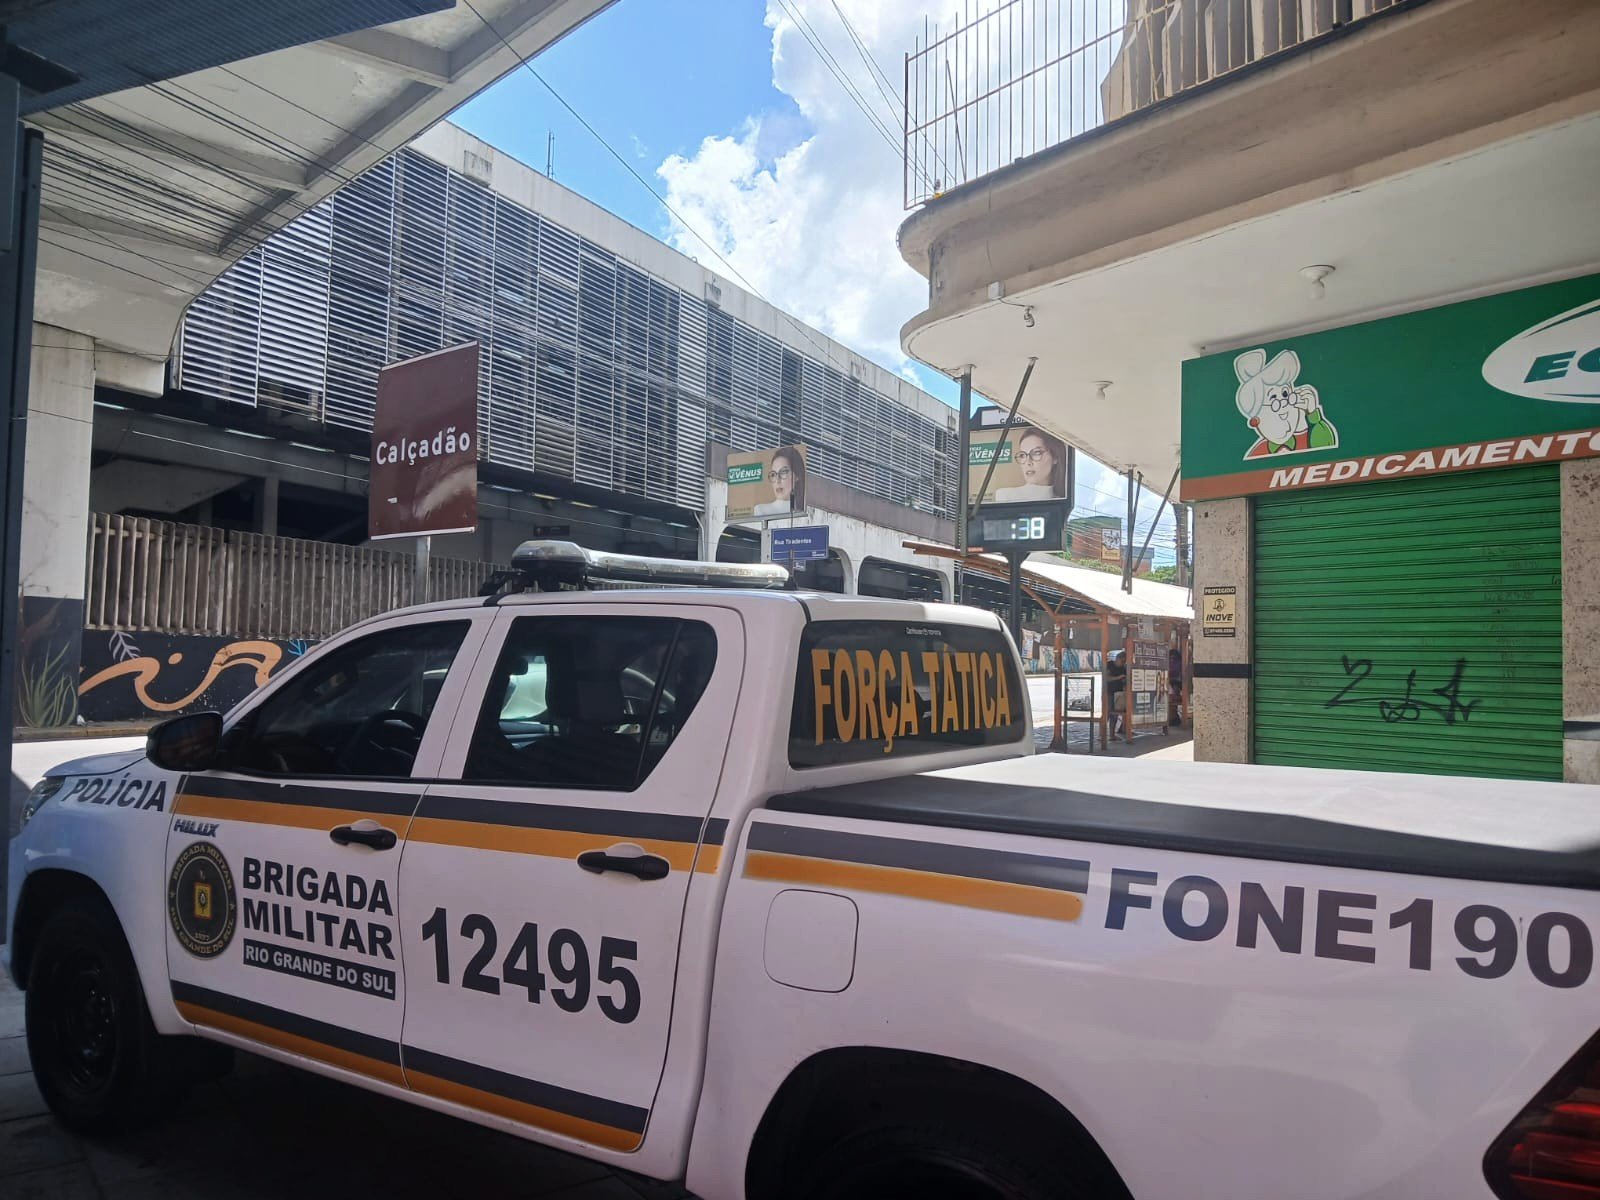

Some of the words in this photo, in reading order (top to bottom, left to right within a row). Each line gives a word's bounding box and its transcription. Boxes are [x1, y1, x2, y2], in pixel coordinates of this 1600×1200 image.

[376, 426, 470, 466] Calçadão
[1206, 613, 1234, 621] INOVE
[811, 649, 918, 752] FORÇA
[921, 643, 1011, 734] TÁTICA
[61, 773, 167, 812] POLÍCIA
[173, 819, 220, 837] HILUX
[172, 844, 205, 880] BRIGADA
[207, 845, 232, 890] MILITAR
[243, 857, 394, 917] BRIGADA
[243, 898, 395, 960] MILITAR
[245, 945, 269, 963] RIO
[273, 951, 332, 979] GRANDE
[336, 965, 358, 985] DO
[362, 972, 393, 994] SUL
[422, 907, 641, 1024] 12495
